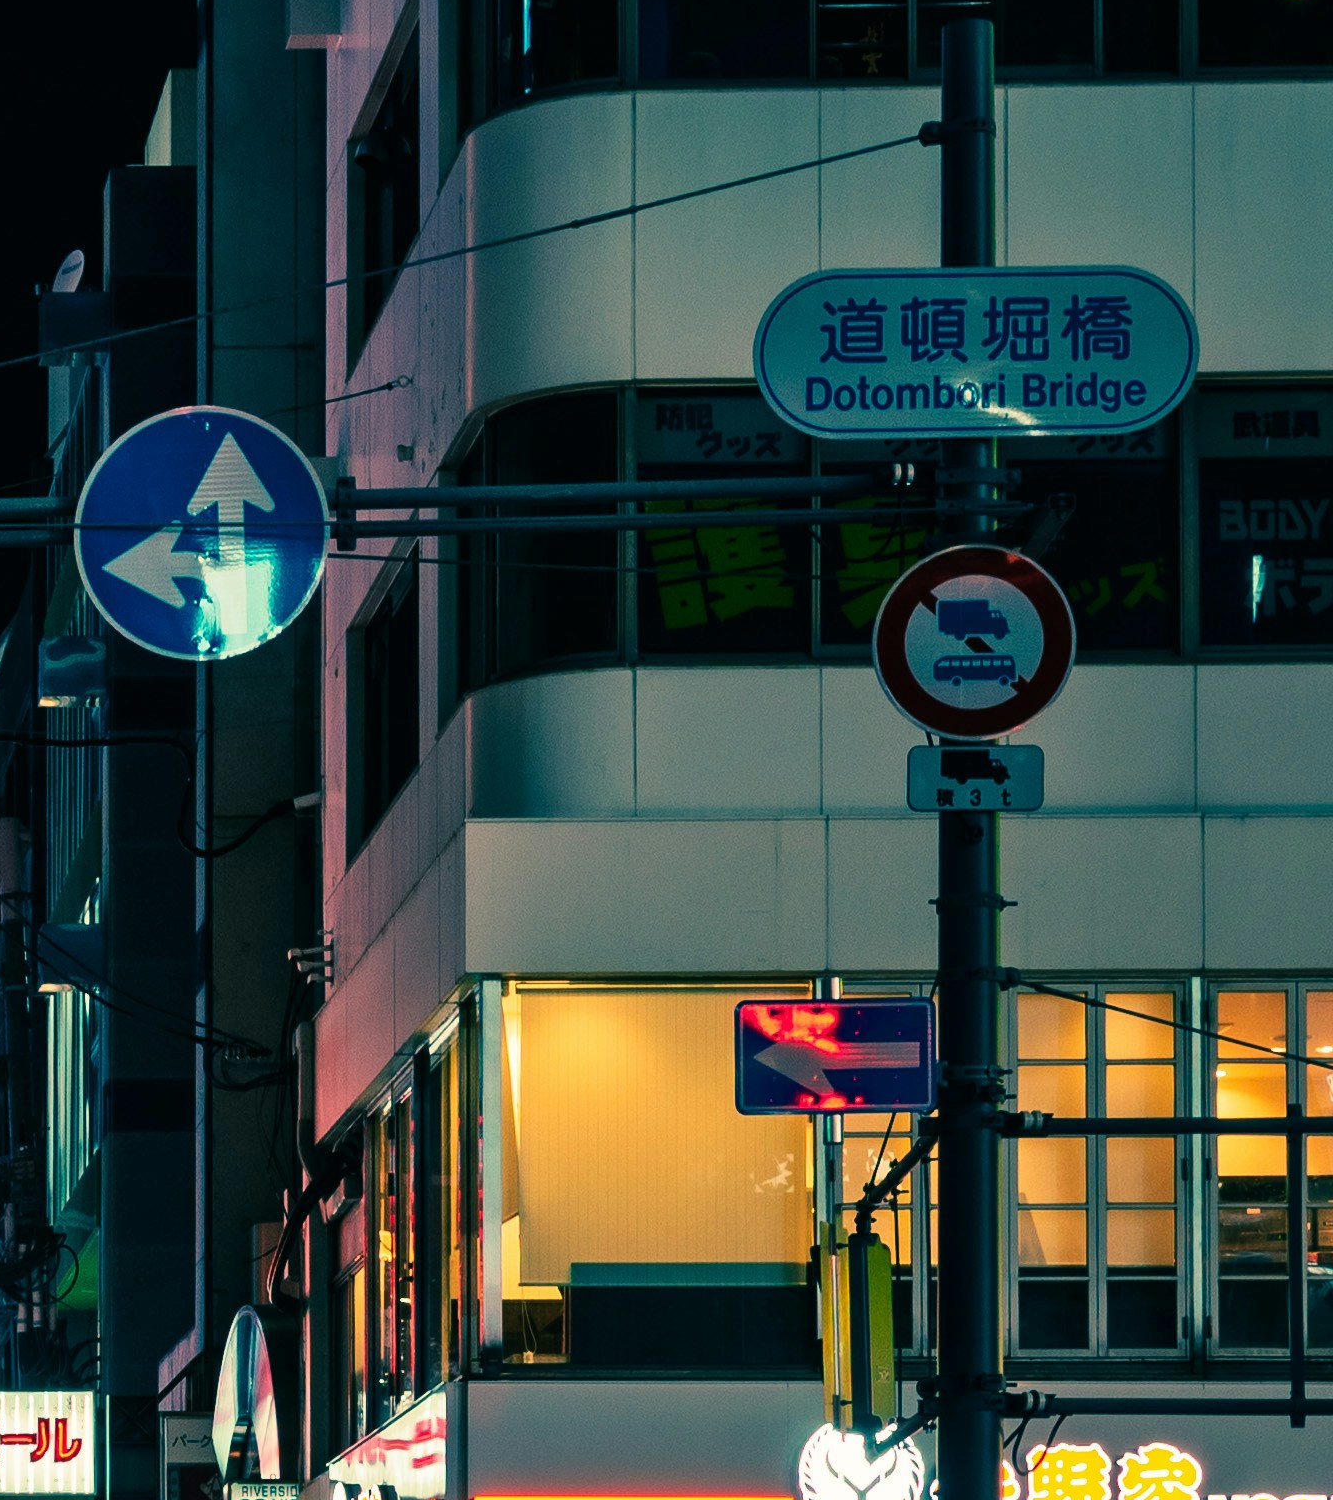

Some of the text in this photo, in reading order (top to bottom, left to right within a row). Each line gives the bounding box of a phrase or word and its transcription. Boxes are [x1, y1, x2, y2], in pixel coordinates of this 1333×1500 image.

[818, 293, 1134, 365] 道頓堀橋
[804, 371, 1148, 414] Dotombori Bridge
